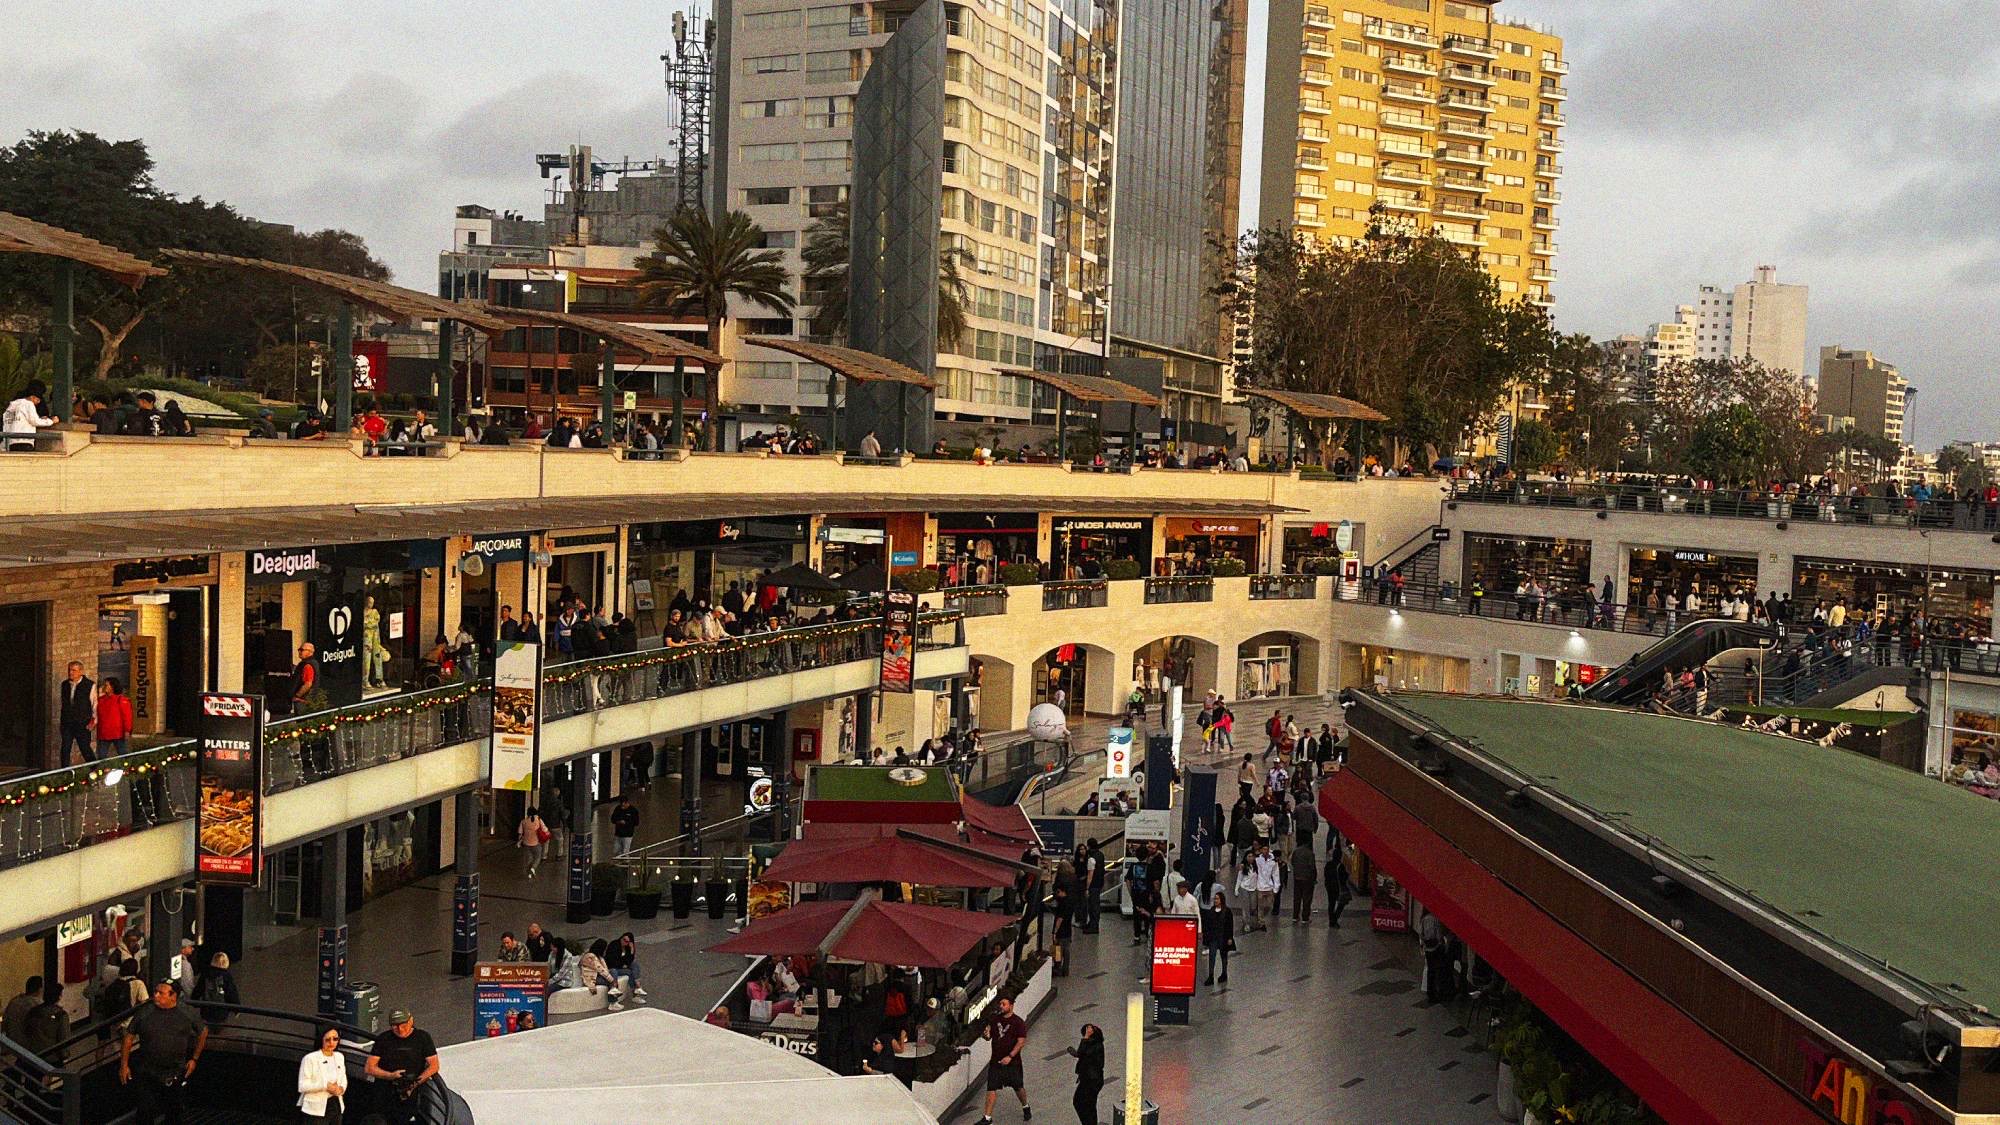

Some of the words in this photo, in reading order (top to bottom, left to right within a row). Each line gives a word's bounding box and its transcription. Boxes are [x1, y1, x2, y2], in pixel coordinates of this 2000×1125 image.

[1684, 552, 1706, 562] HOME
[135, 646, 149, 719] patagonia
[204, 739, 250, 750] PLATTERS
